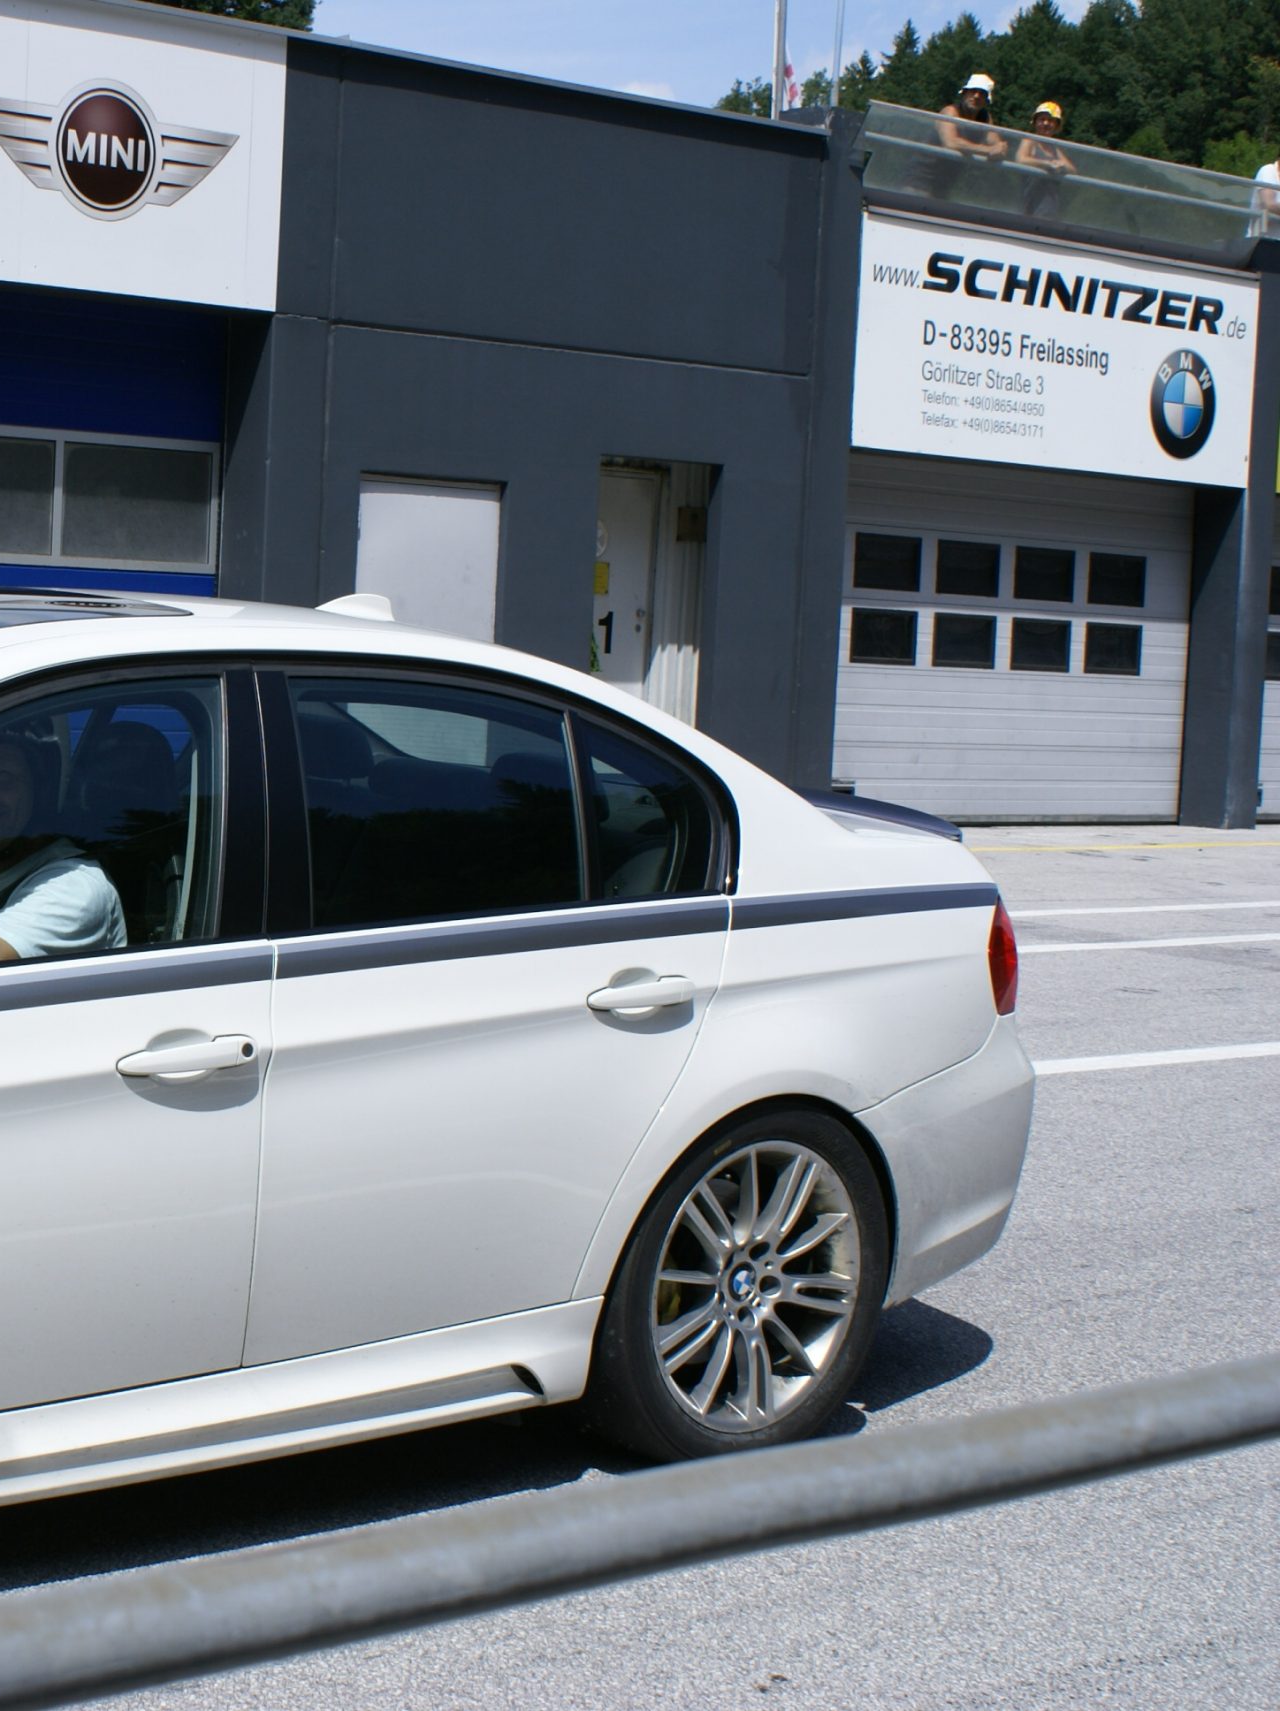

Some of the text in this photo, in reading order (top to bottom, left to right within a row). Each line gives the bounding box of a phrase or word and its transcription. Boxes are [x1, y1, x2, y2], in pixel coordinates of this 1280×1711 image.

[66, 128, 146, 172] MINI
[922, 319, 1110, 376] D-83395 Freilassing
[921, 360, 1044, 395] Görlitzer Straße 3
[1158, 351, 1212, 391] BMW
[921, 389, 960, 407] Telefon:
[920, 411, 958, 428] Telefax:
